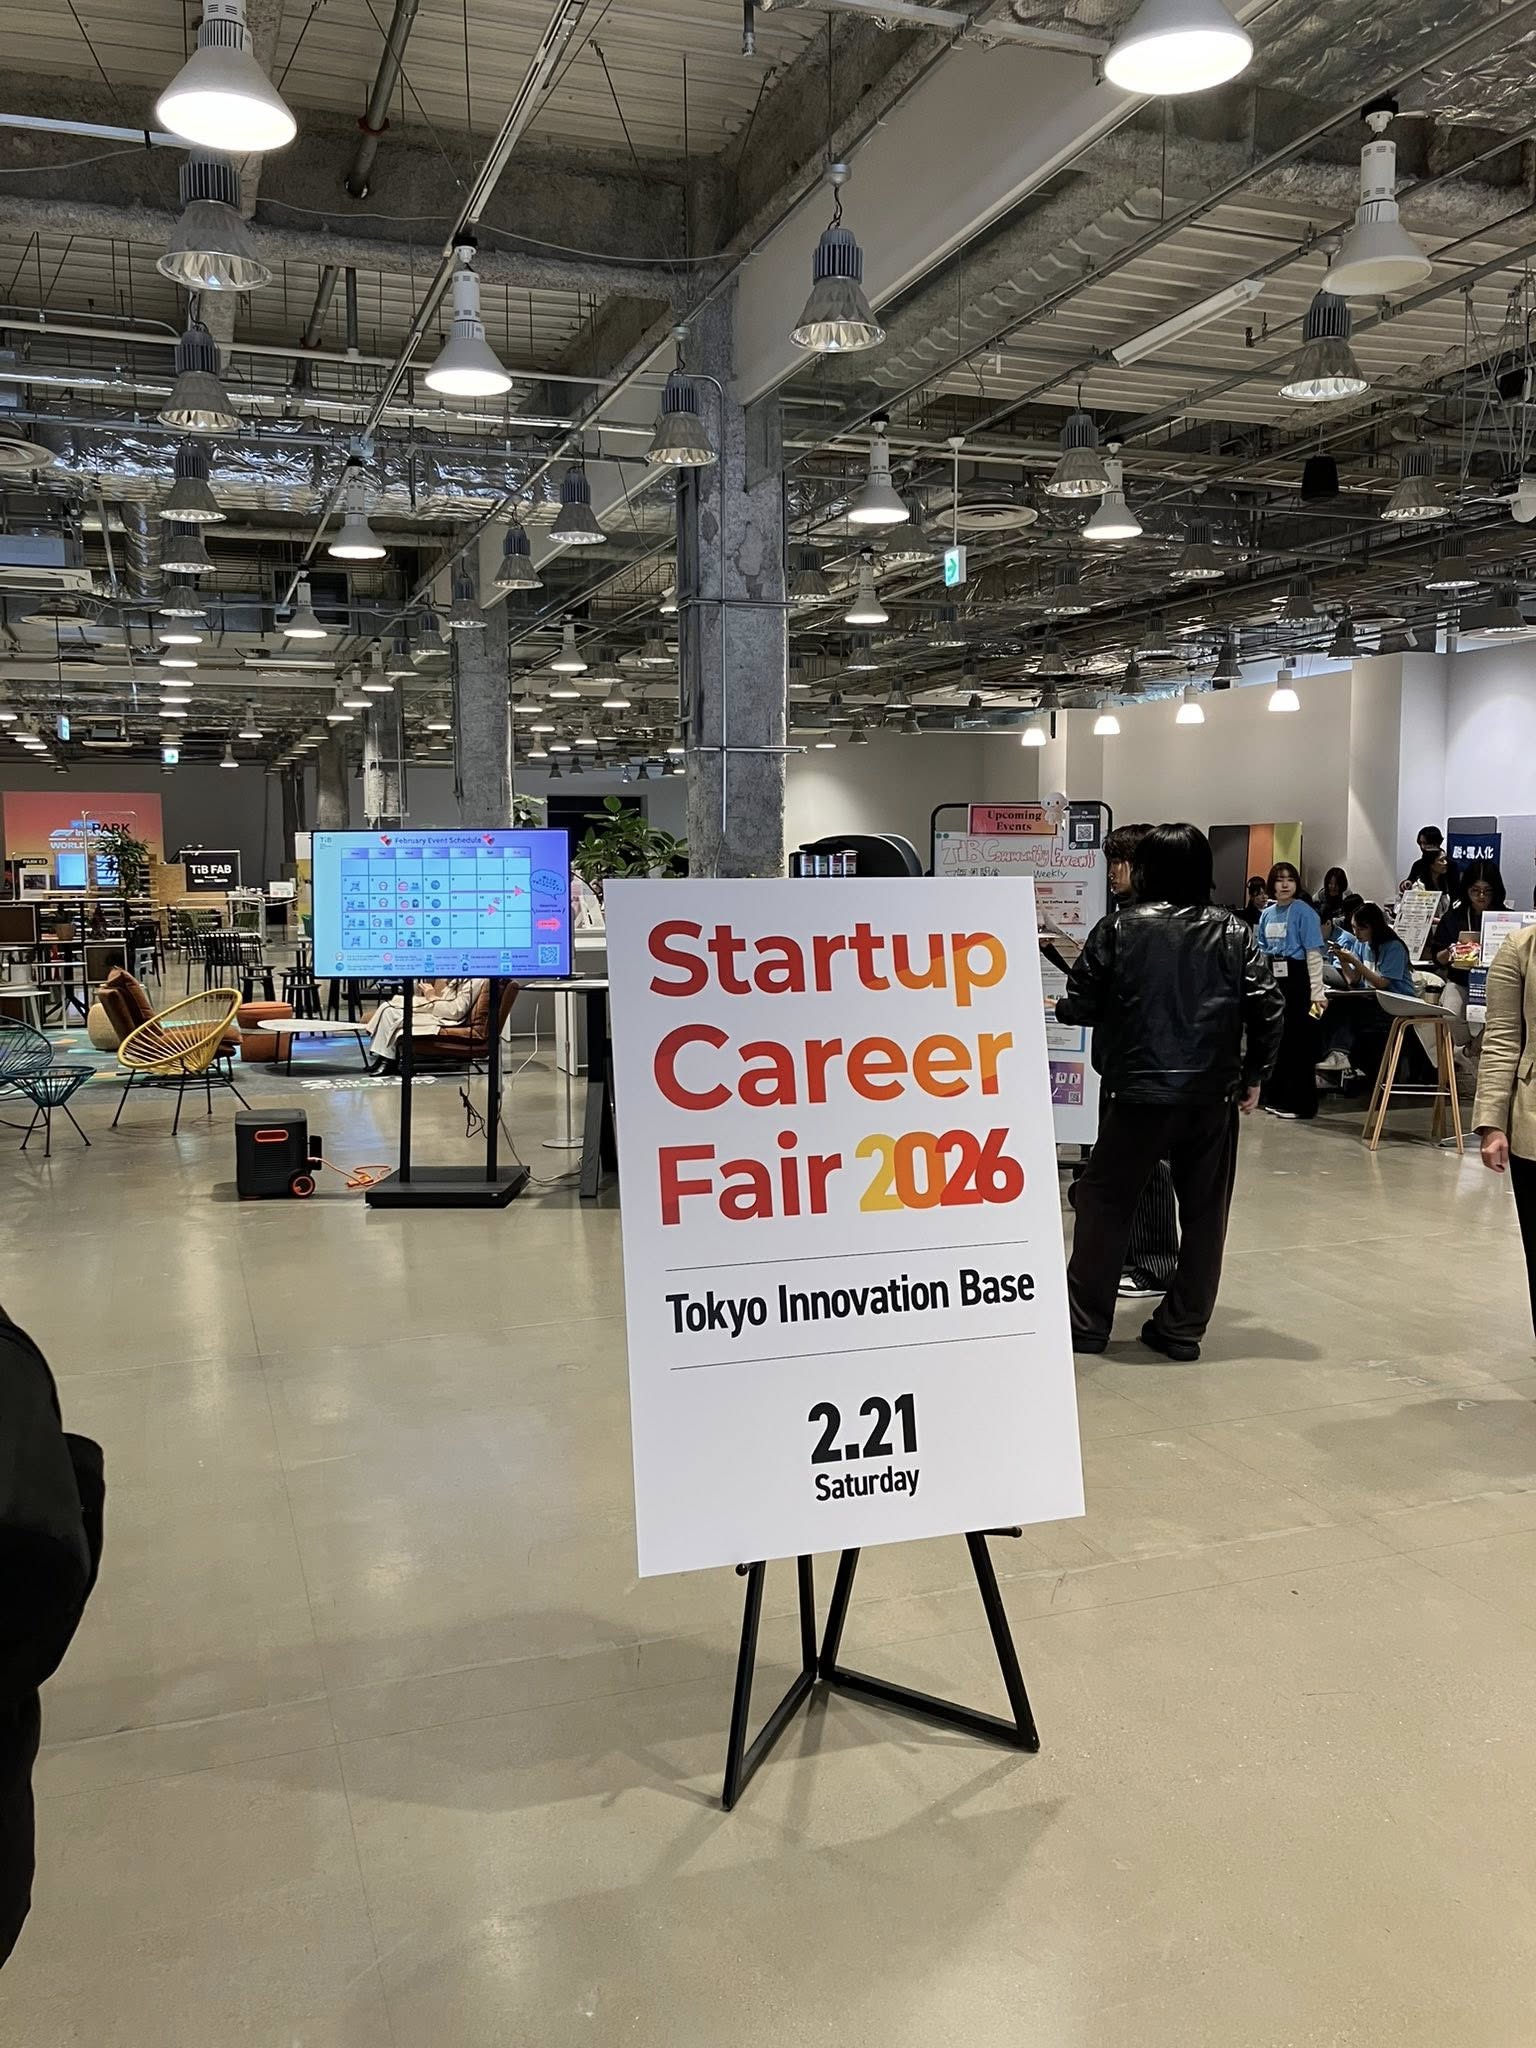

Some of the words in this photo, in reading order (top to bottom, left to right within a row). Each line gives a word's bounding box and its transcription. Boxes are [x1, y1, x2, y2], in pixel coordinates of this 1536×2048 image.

[987, 810, 1042, 821] Upcoming
[996, 822, 1032, 831] Events
[92, 823, 130, 834] PARK
[395, 837, 427, 846] February
[189, 864, 209, 874] TiB
[210, 864, 232, 874] FAB
[1033, 869, 1068, 879] Weekly
[648, 920, 1008, 1008] Startup
[654, 1024, 1014, 1112] Career
[658, 1130, 842, 1226] Fair
[855, 1128, 1025, 1213] 2026
[666, 1291, 768, 1339] Tokyo
[778, 1274, 950, 1324] Innovation
[959, 1268, 1035, 1307] Base
[807, 1393, 919, 1465] 2.21
[814, 1466, 921, 1502] Saturday
